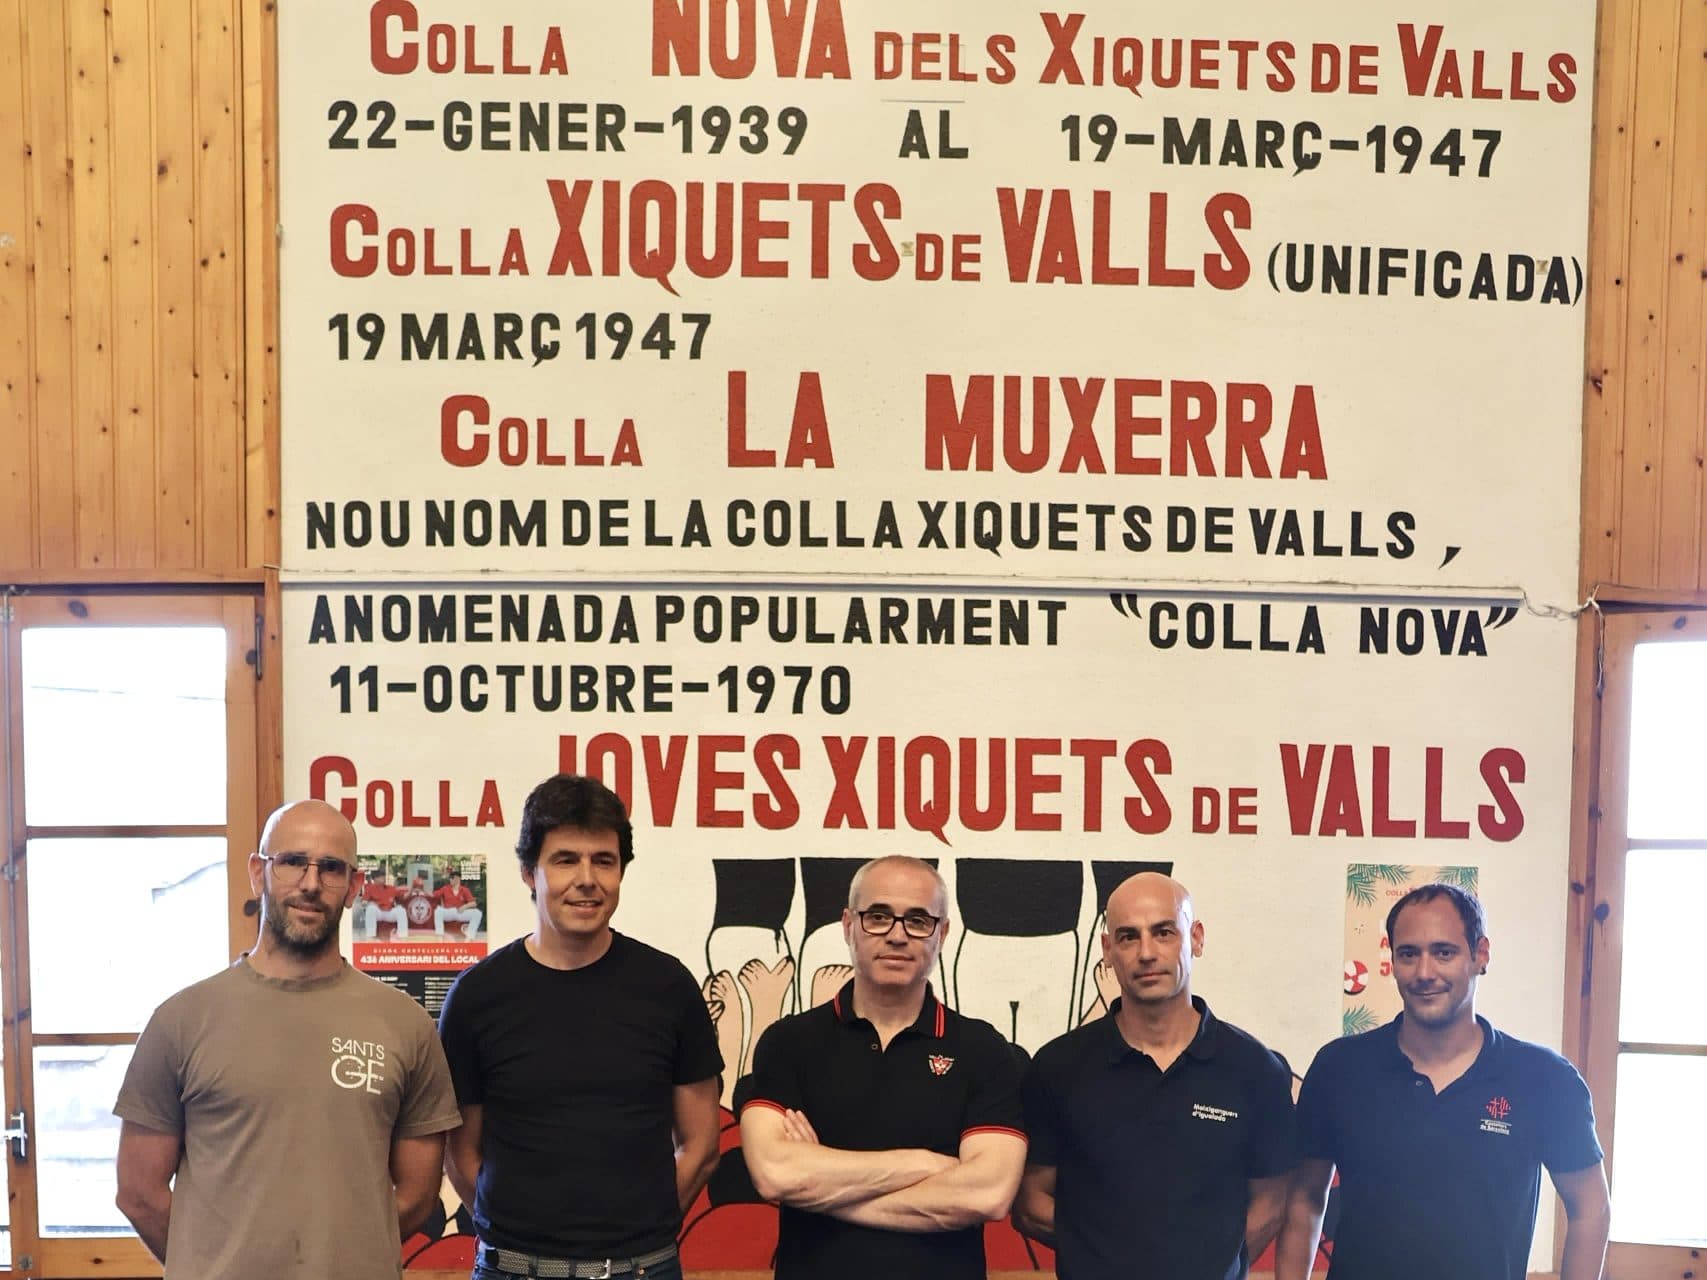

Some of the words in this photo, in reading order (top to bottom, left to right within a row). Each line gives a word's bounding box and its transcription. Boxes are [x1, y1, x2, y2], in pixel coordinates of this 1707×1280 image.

[371, 0, 567, 73] COLLA
[653, 0, 850, 78] NOVA
[875, 32, 1015, 83] DELS
[1041, 13, 1295, 97] XIQUETS
[1312, 44, 1378, 93] DE
[1398, 24, 1576, 101] VALLS
[329, 101, 807, 154] 22-GENER-1939
[900, 110, 968, 159] AL
[1062, 115, 1501, 177] 19-MARÇ-1947
[331, 204, 527, 276] COLLA
[549, 180, 900, 297] XIQUETS
[916, 233, 980, 280] DE
[998, 188, 1250, 289] VALLS
[1268, 243, 1582, 304] (UNIFICADA)
[329, 313, 384, 360] 19
[402, 313, 560, 366] MARÇ
[576, 313, 710, 360] 1947
[442, 395, 640, 466] COLLA
[728, 371, 833, 467] LA
[925, 374, 1327, 478] MUXERRA
[307, 501, 409, 549] NOU
[426, 500, 546, 546] NOM
[563, 500, 628, 546] DE
[645, 500, 711, 547] LA
[728, 500, 902, 548] COLLA
[918, 501, 1151, 556] XIQUETS
[1168, 507, 1233, 552] DE
[1249, 509, 1415, 559] VALLS
[310, 595, 638, 643] ANOMENADA
[657, 596, 1066, 644] POPULARMENT
[331, 665, 850, 714] 11-OCTUBRE-1970
[824, 735, 1172, 846] XIQUETS
[1193, 787, 1257, 833] DE
[1280, 743, 1524, 840] VALLS
[378, 955, 432, 964] ANIVERSARI
[432, 955, 451, 964] DEL
[331, 1036, 385, 1060] SANTS
[331, 1054, 385, 1095] GE
